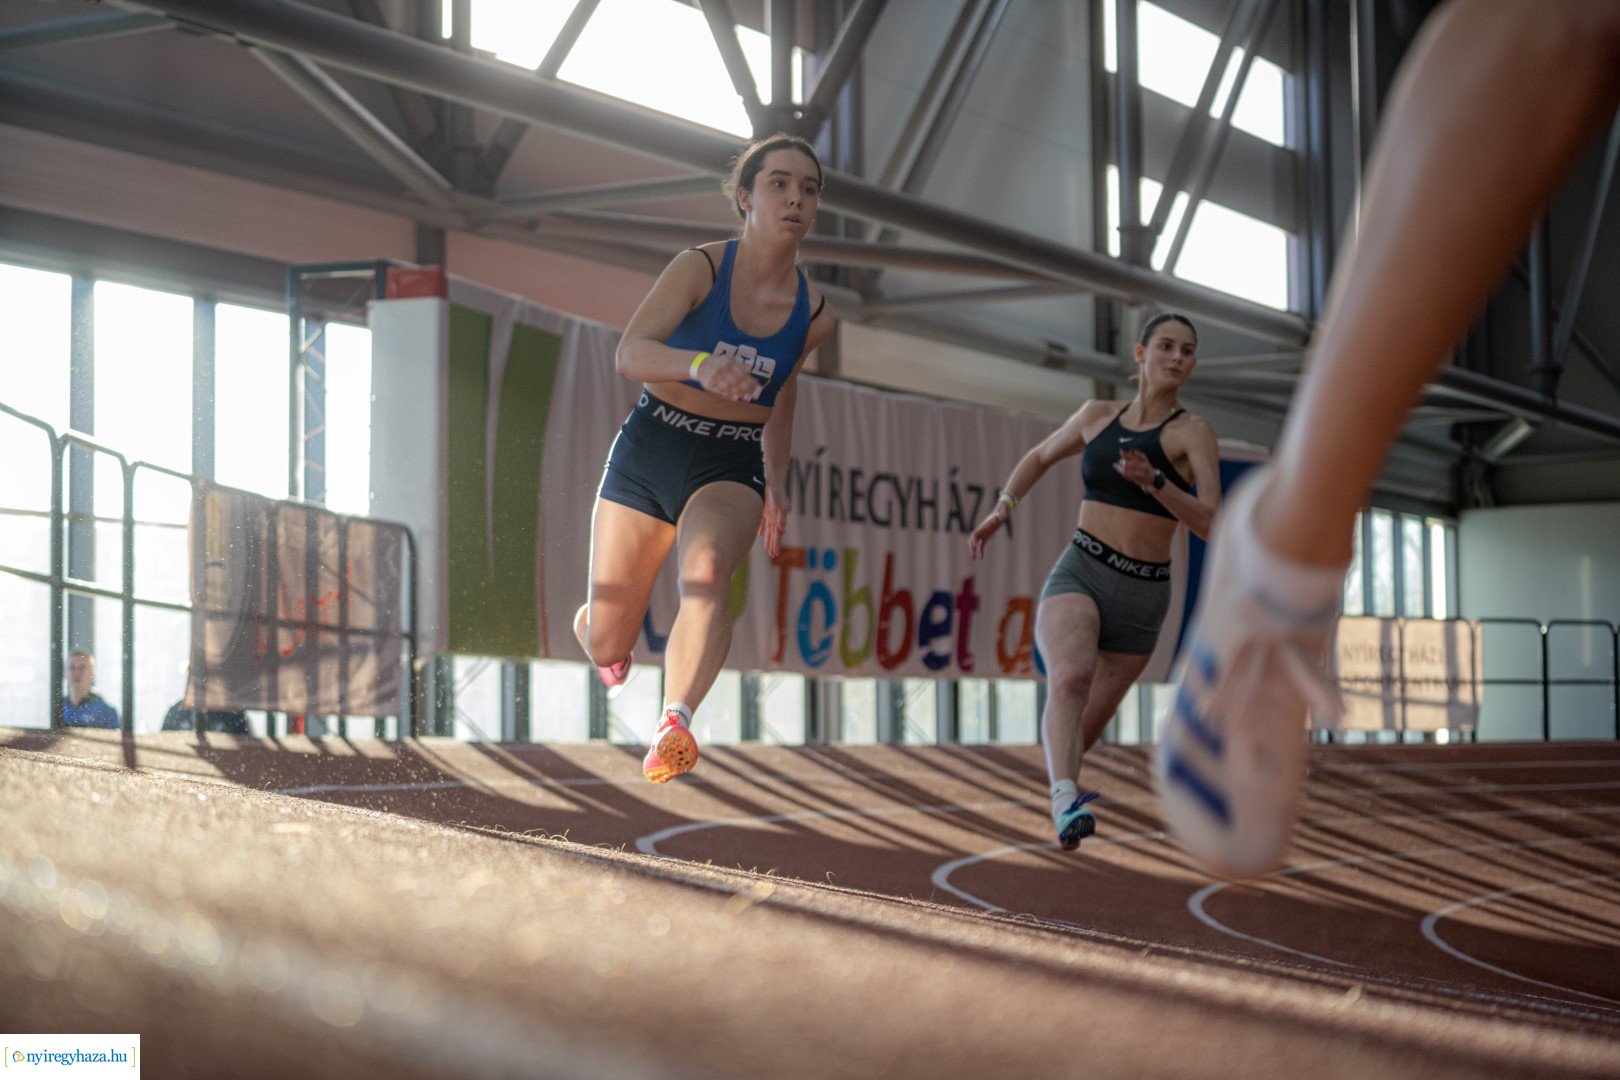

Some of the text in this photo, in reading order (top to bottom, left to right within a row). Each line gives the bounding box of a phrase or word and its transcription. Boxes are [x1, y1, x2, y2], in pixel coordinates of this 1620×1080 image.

[652, 404, 717, 436] NIKE
[716, 424, 764, 441] PRO
[1107, 554, 1154, 577] NIKE
[1155, 566, 1171, 578] P
[771, 546, 1046, 676] Többet a
